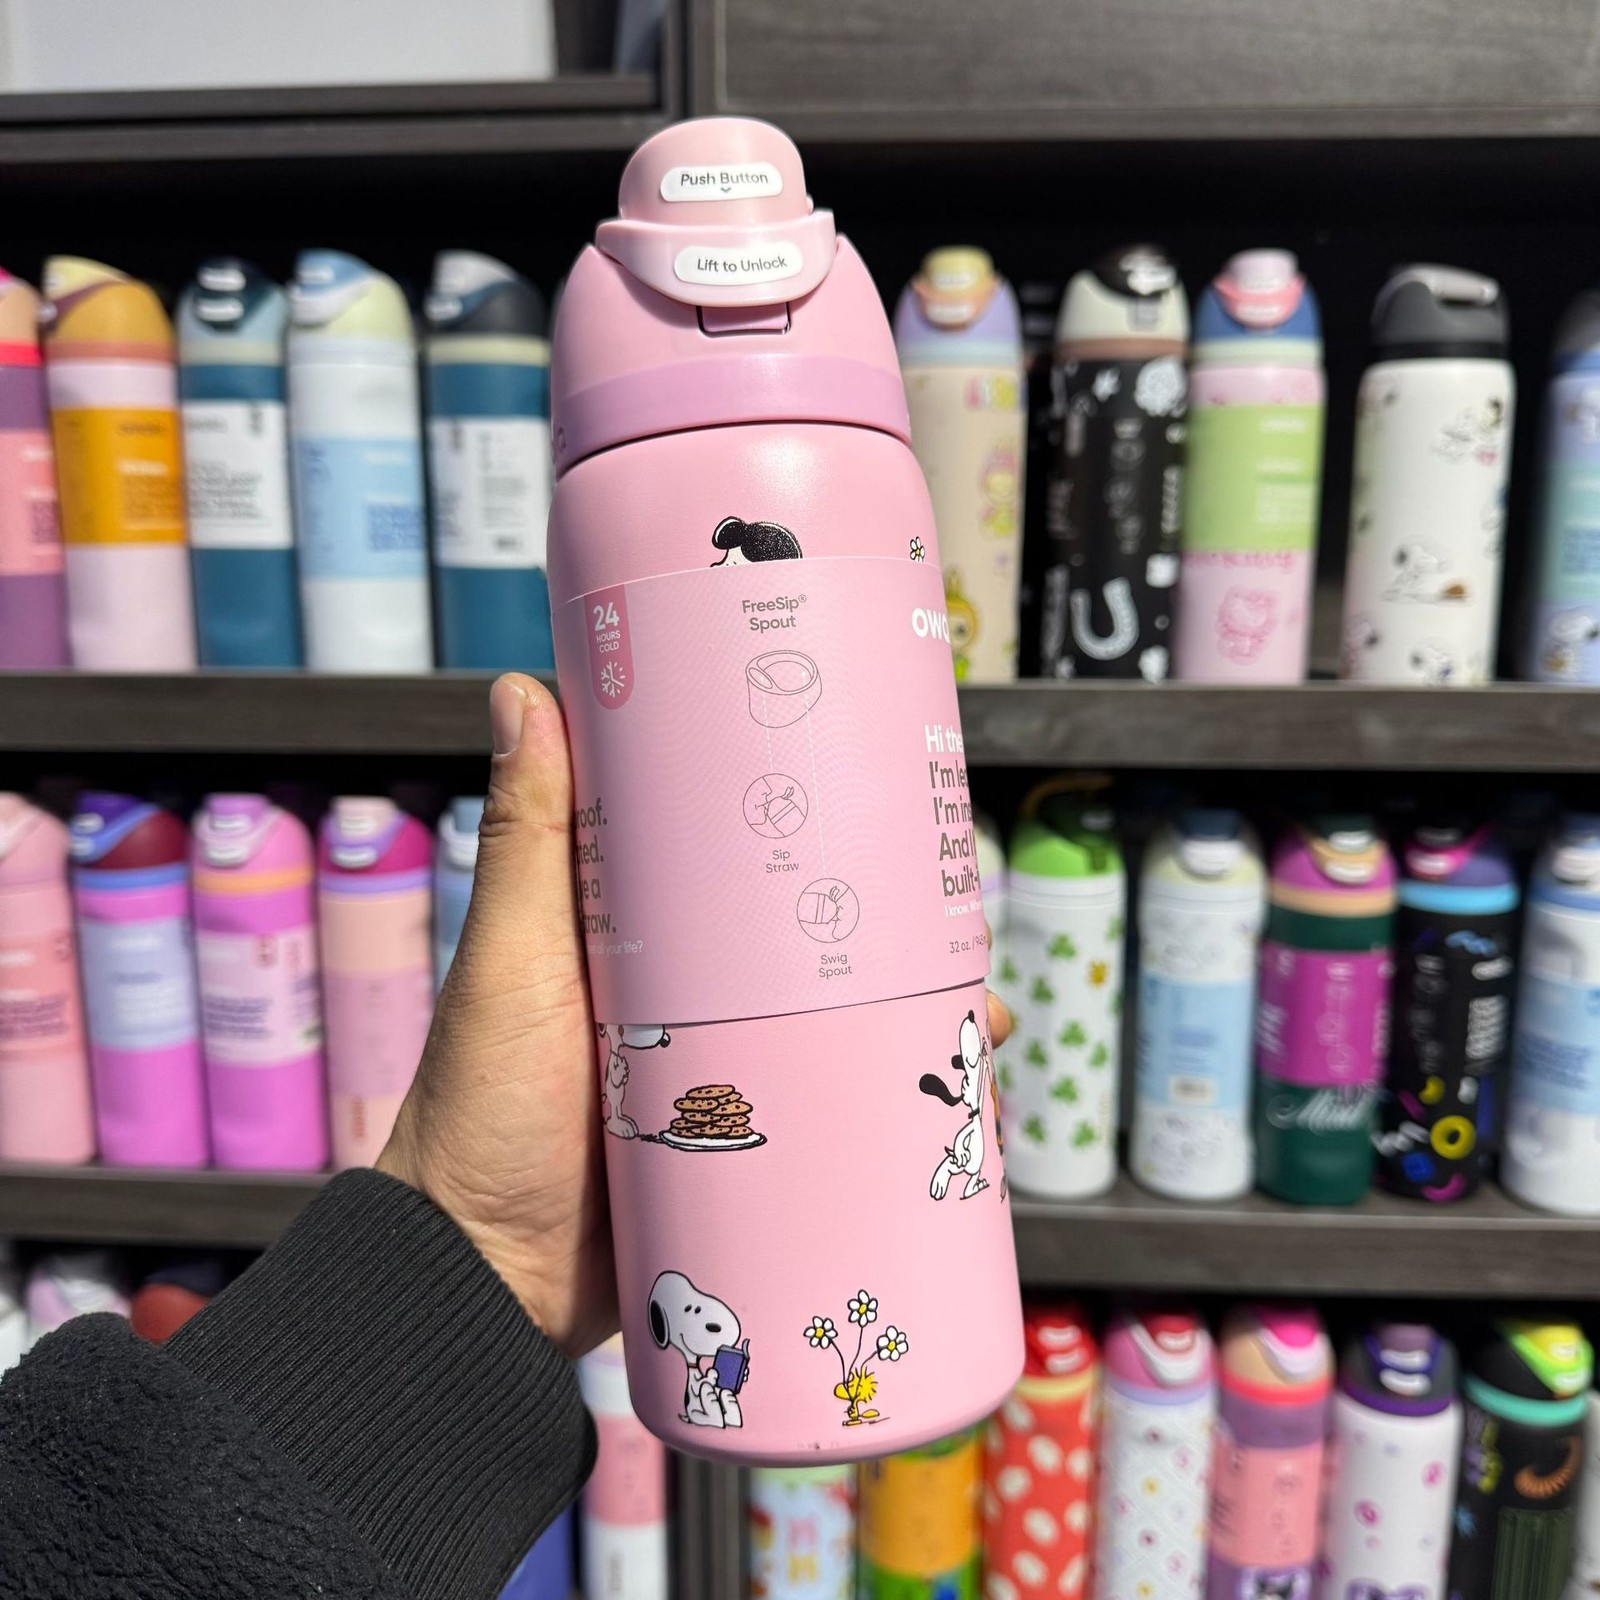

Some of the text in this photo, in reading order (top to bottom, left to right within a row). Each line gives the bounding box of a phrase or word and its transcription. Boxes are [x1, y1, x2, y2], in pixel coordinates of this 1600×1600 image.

[681, 172, 769, 187] Push Button
[697, 255, 788, 272] Lift to Unlock
[593, 602, 620, 631] 24
[749, 615, 796, 634] Spout
[596, 629, 621, 643] HOURS
[600, 641, 620, 653] COLD
[925, 724, 944, 753] Hi
[929, 761, 955, 789] I'm
[933, 796, 960, 825] I'm
[939, 830, 969, 861] And
[771, 849, 791, 862] Sip
[765, 861, 800, 873] Straw
[591, 878, 601, 900] a
[949, 941, 960, 954] 32
[820, 953, 848, 965] Swig
[818, 965, 853, 979] Spout
